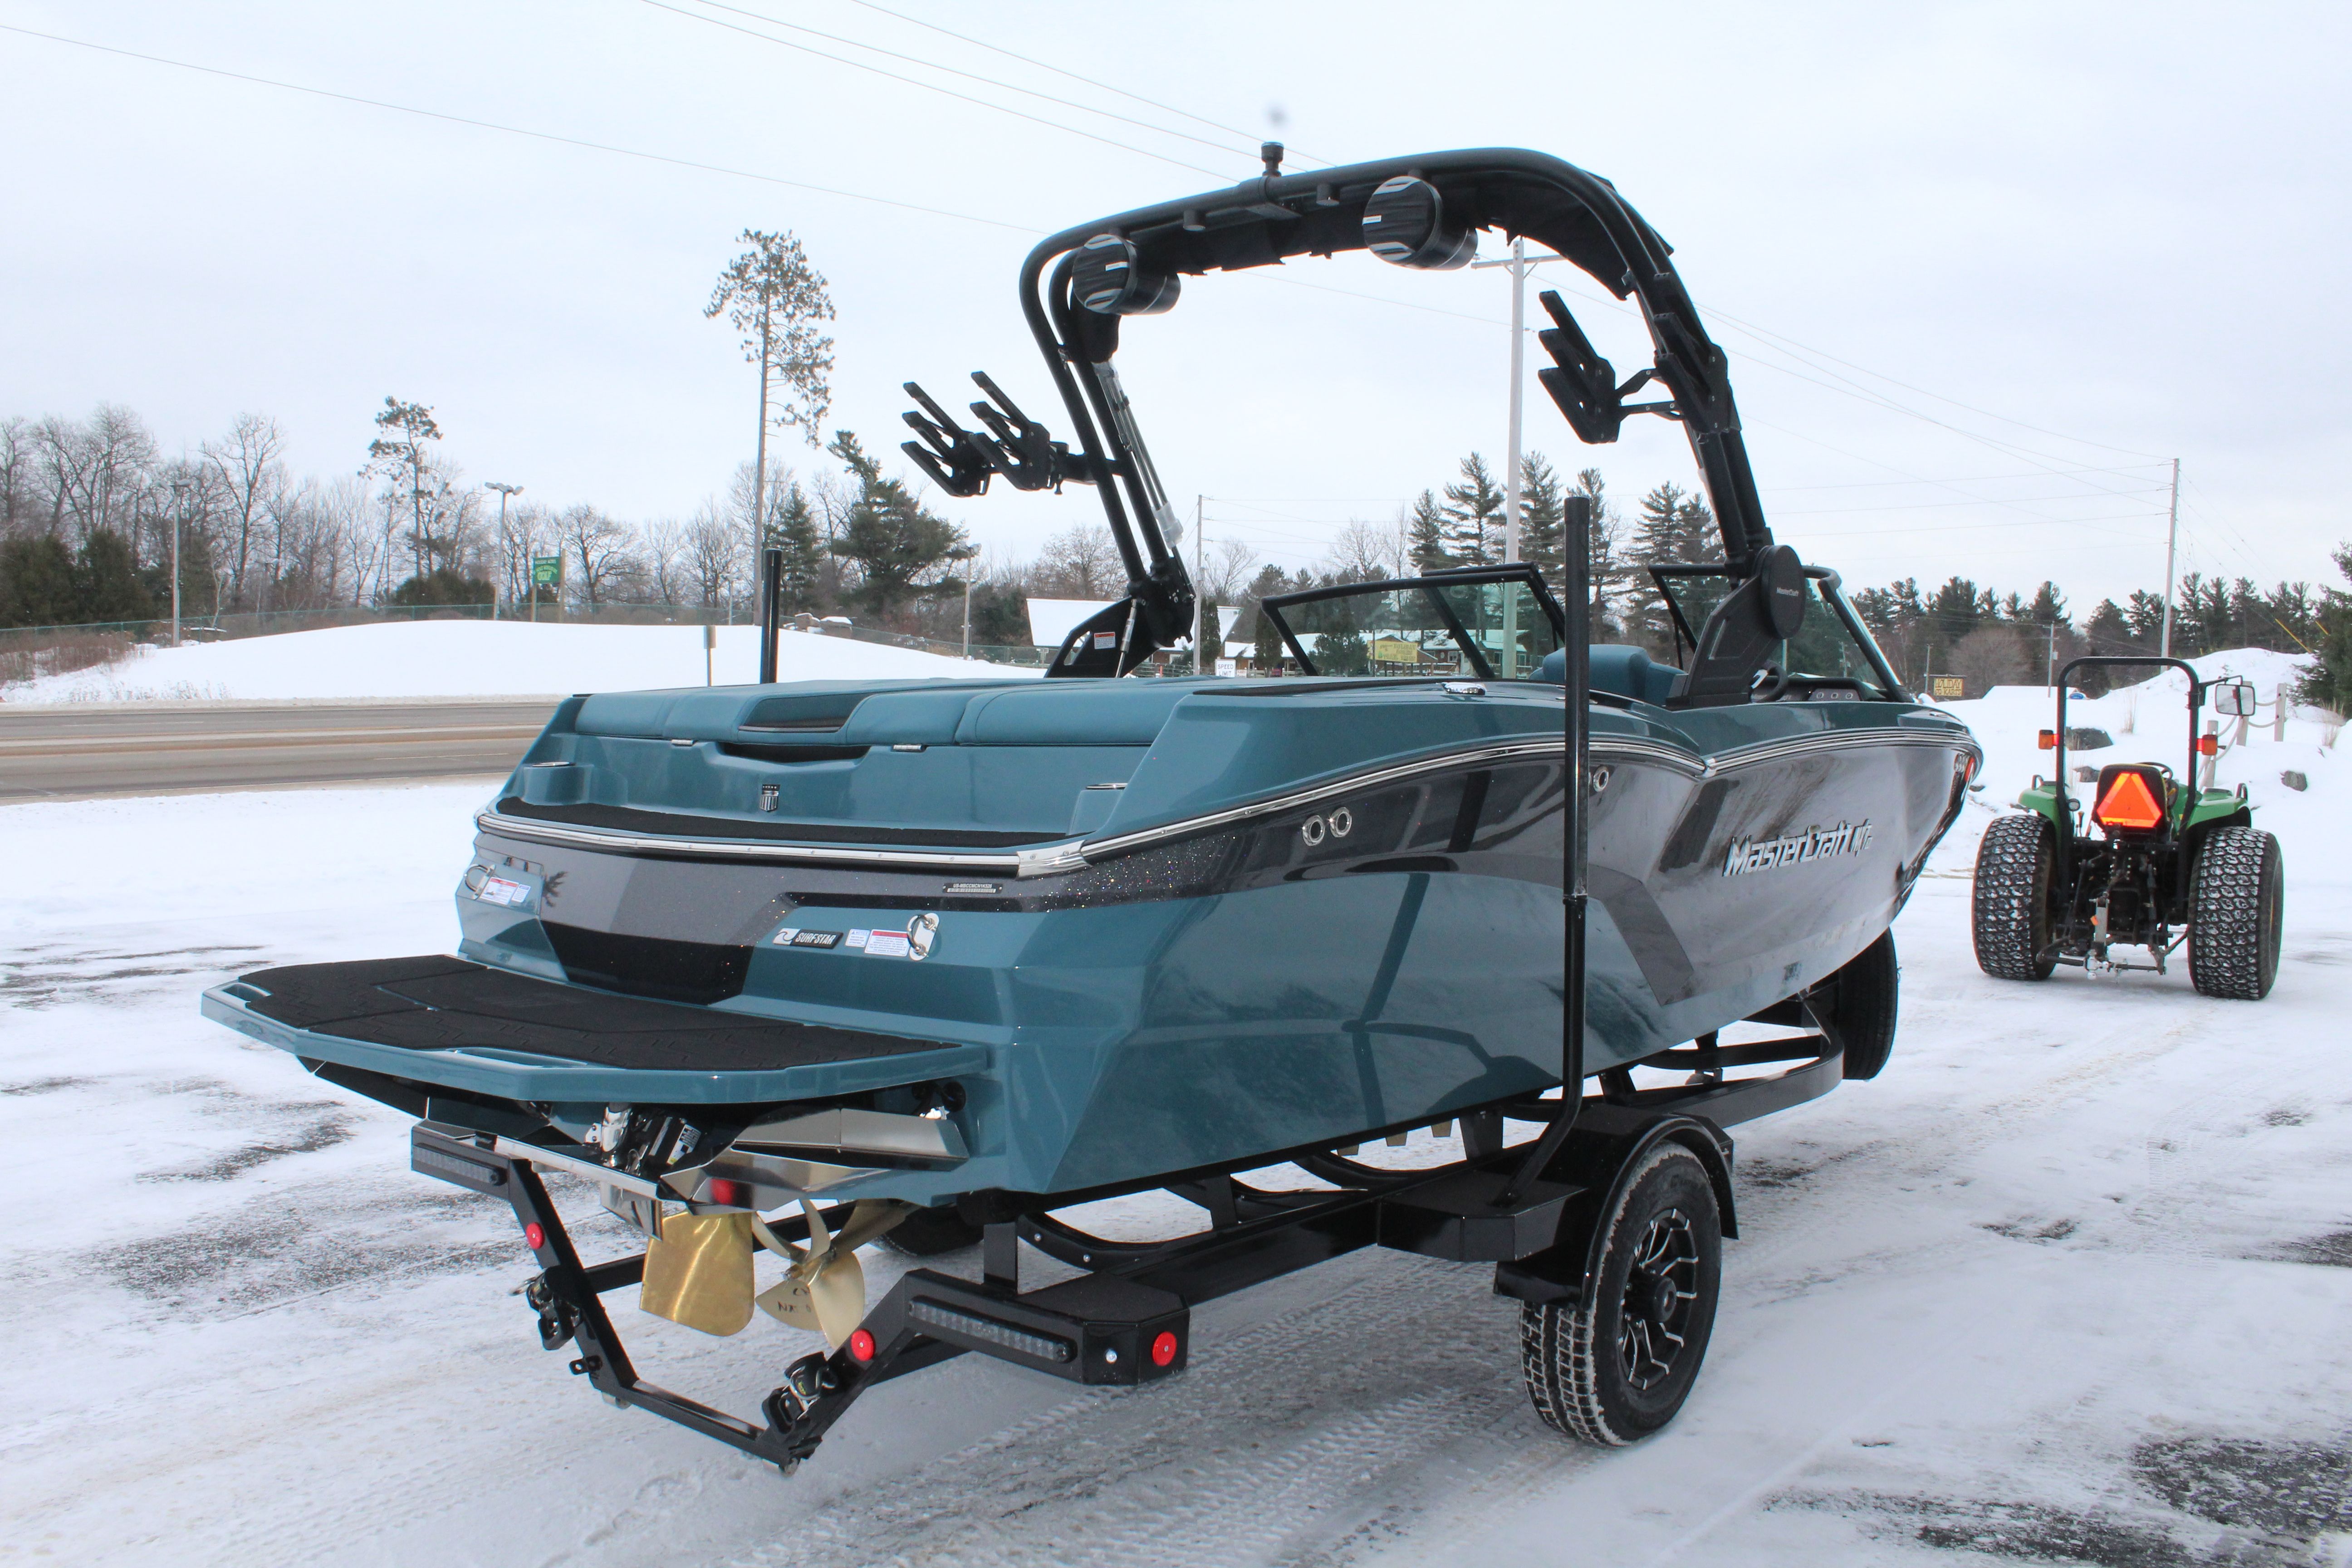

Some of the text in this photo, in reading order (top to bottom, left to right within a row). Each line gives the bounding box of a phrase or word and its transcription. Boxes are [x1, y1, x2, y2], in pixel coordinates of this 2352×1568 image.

[1935, 679, 1961, 688] HOLIDAY
[1723, 820, 1852, 877] MasterCraft
[795, 932, 837, 945] SURFSTAR
